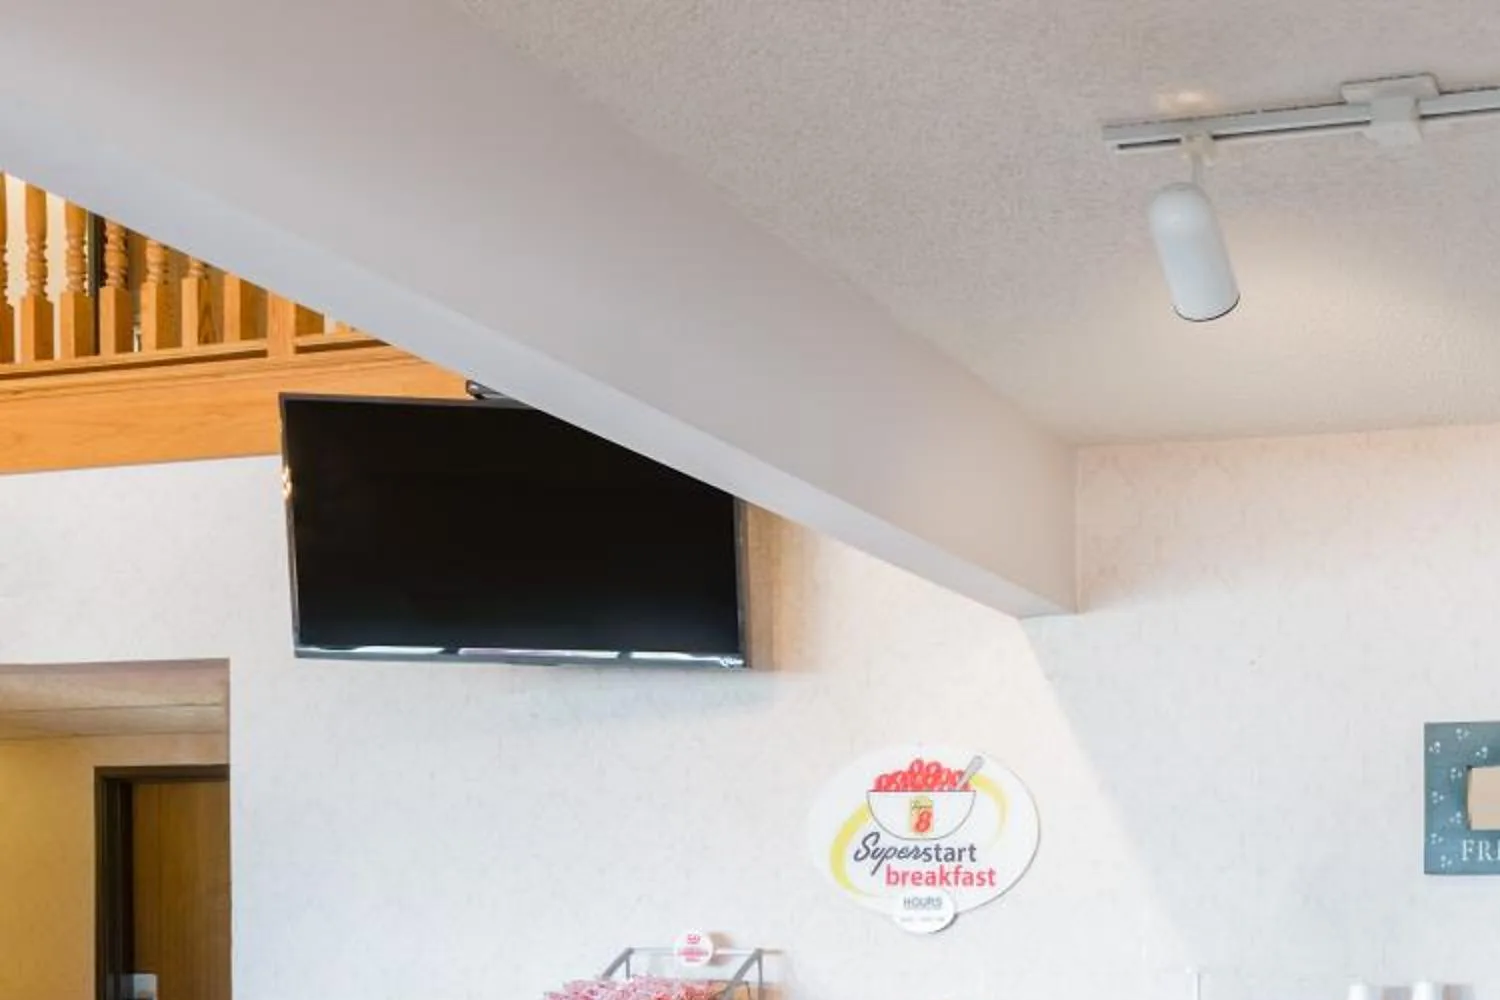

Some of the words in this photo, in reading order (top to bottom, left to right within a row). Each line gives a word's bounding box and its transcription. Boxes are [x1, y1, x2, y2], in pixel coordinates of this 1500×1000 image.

[854, 831, 977, 876] Superstart
[886, 864, 997, 887] breakfast
[903, 896, 943, 910] HOURS
